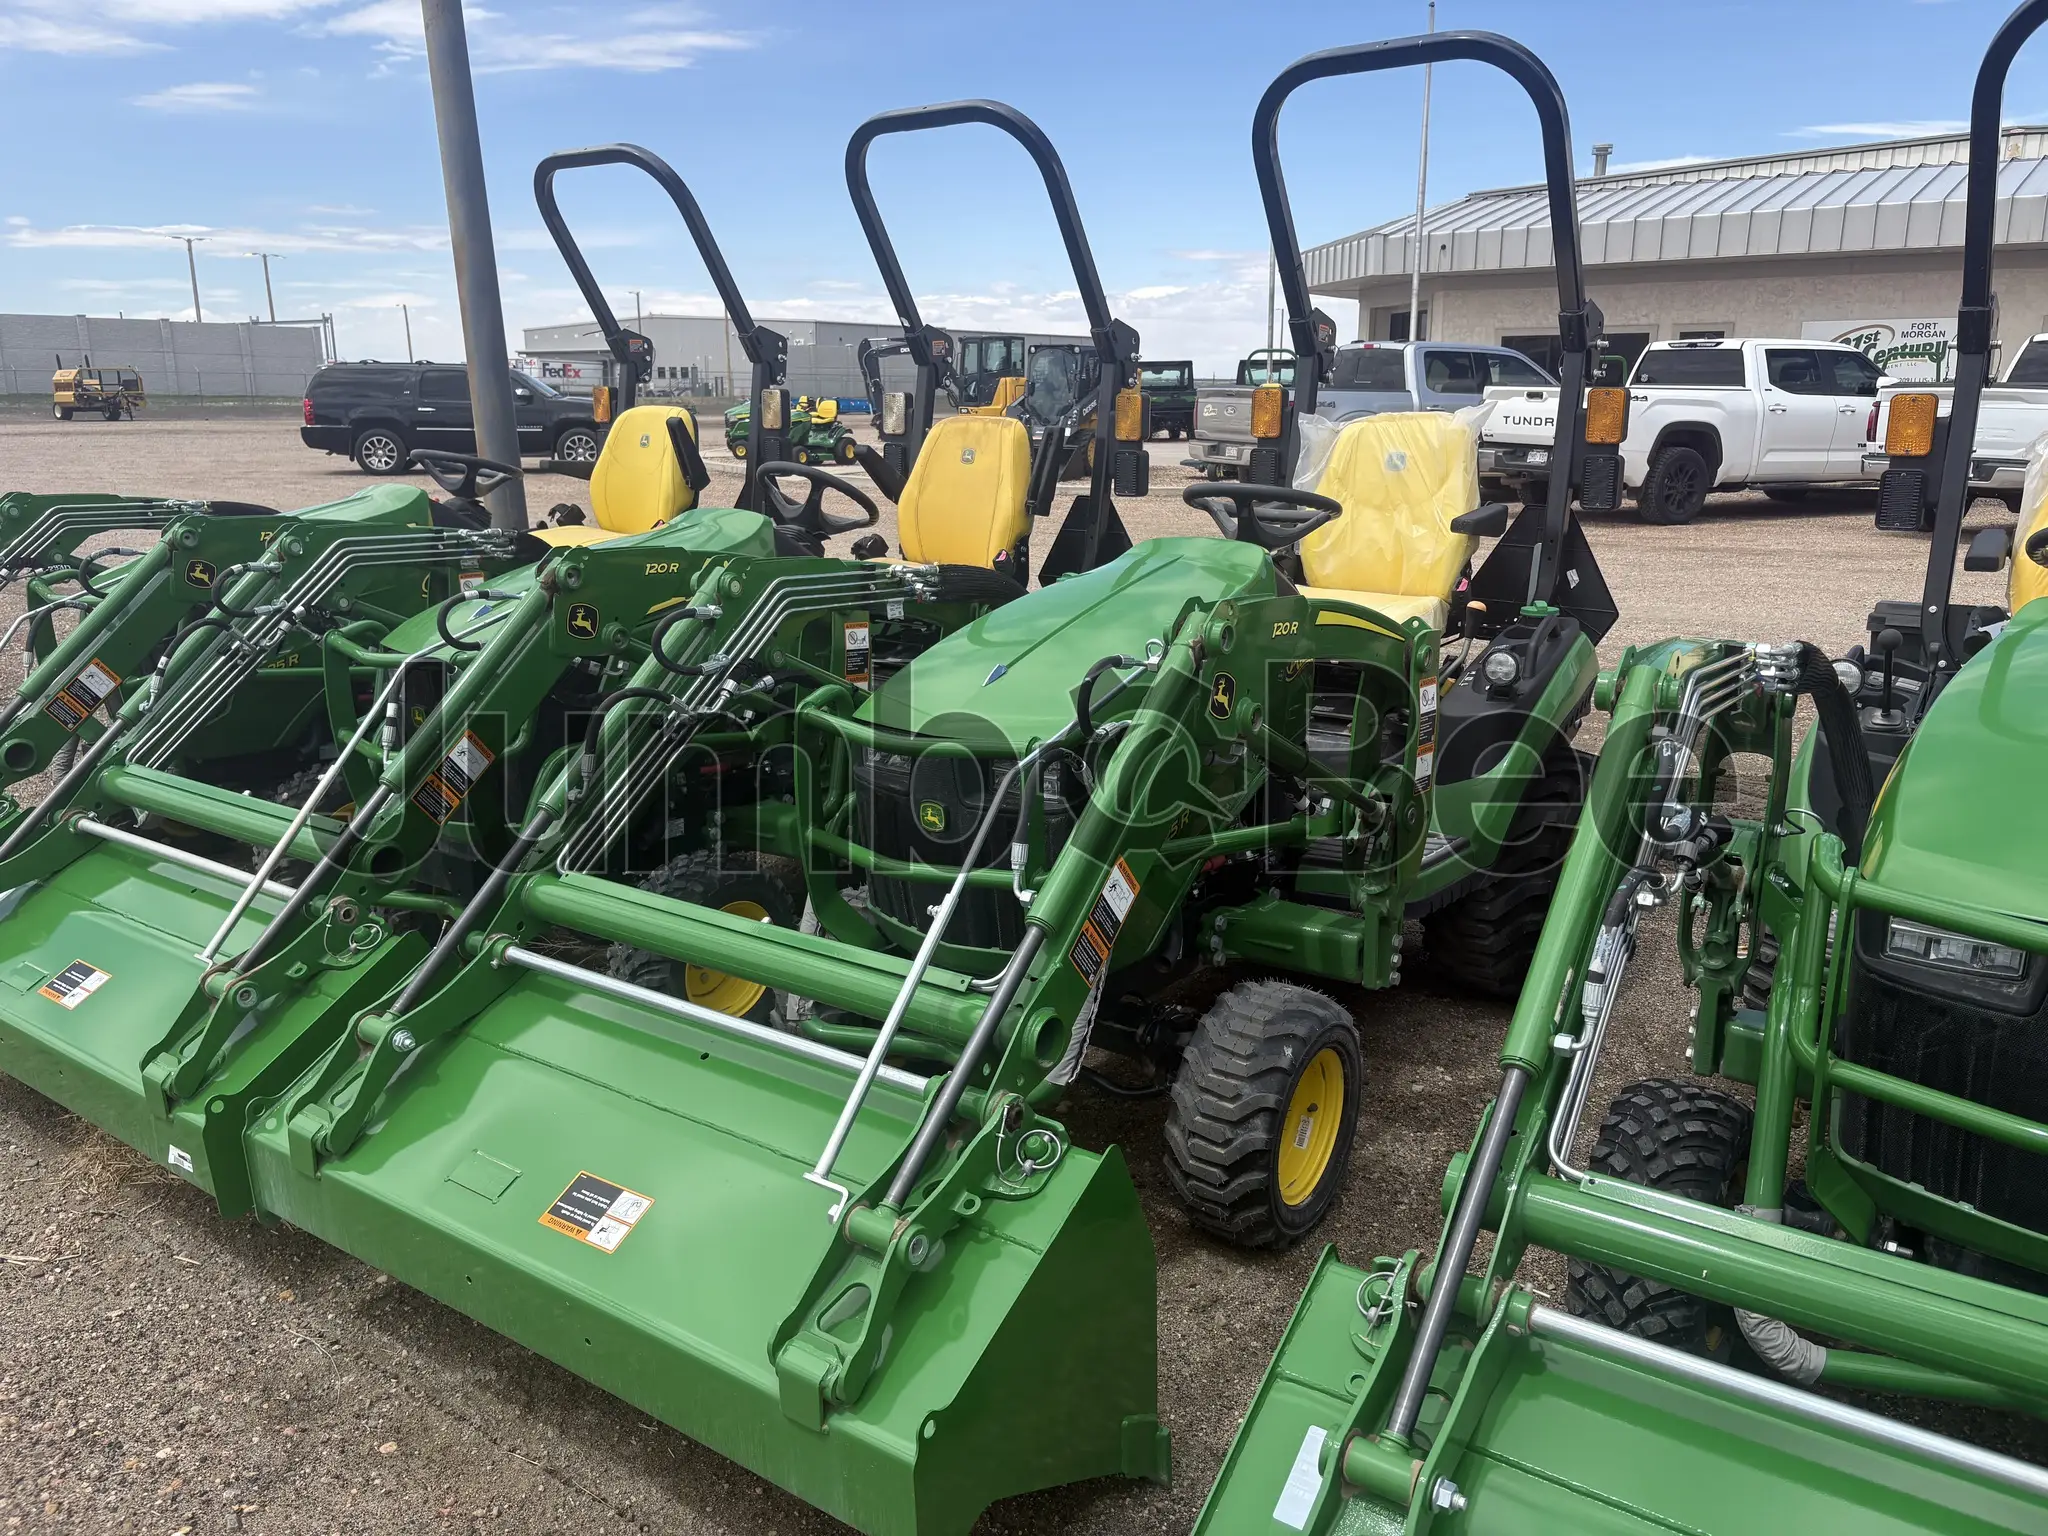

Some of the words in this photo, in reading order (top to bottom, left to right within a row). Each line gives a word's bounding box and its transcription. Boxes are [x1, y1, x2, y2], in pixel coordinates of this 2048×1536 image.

[1910, 322, 1938, 331] FORT
[1901, 330, 1946, 339] MORGAN
[542, 362, 582, 379] FedEx
[1503, 415, 1555, 427] TUNDR
[645, 563, 667, 576] 120
[669, 563, 679, 573] R
[1272, 621, 1290, 639] 120
[1290, 621, 1299, 635] R
[547, 1217, 576, 1234] WARNING
